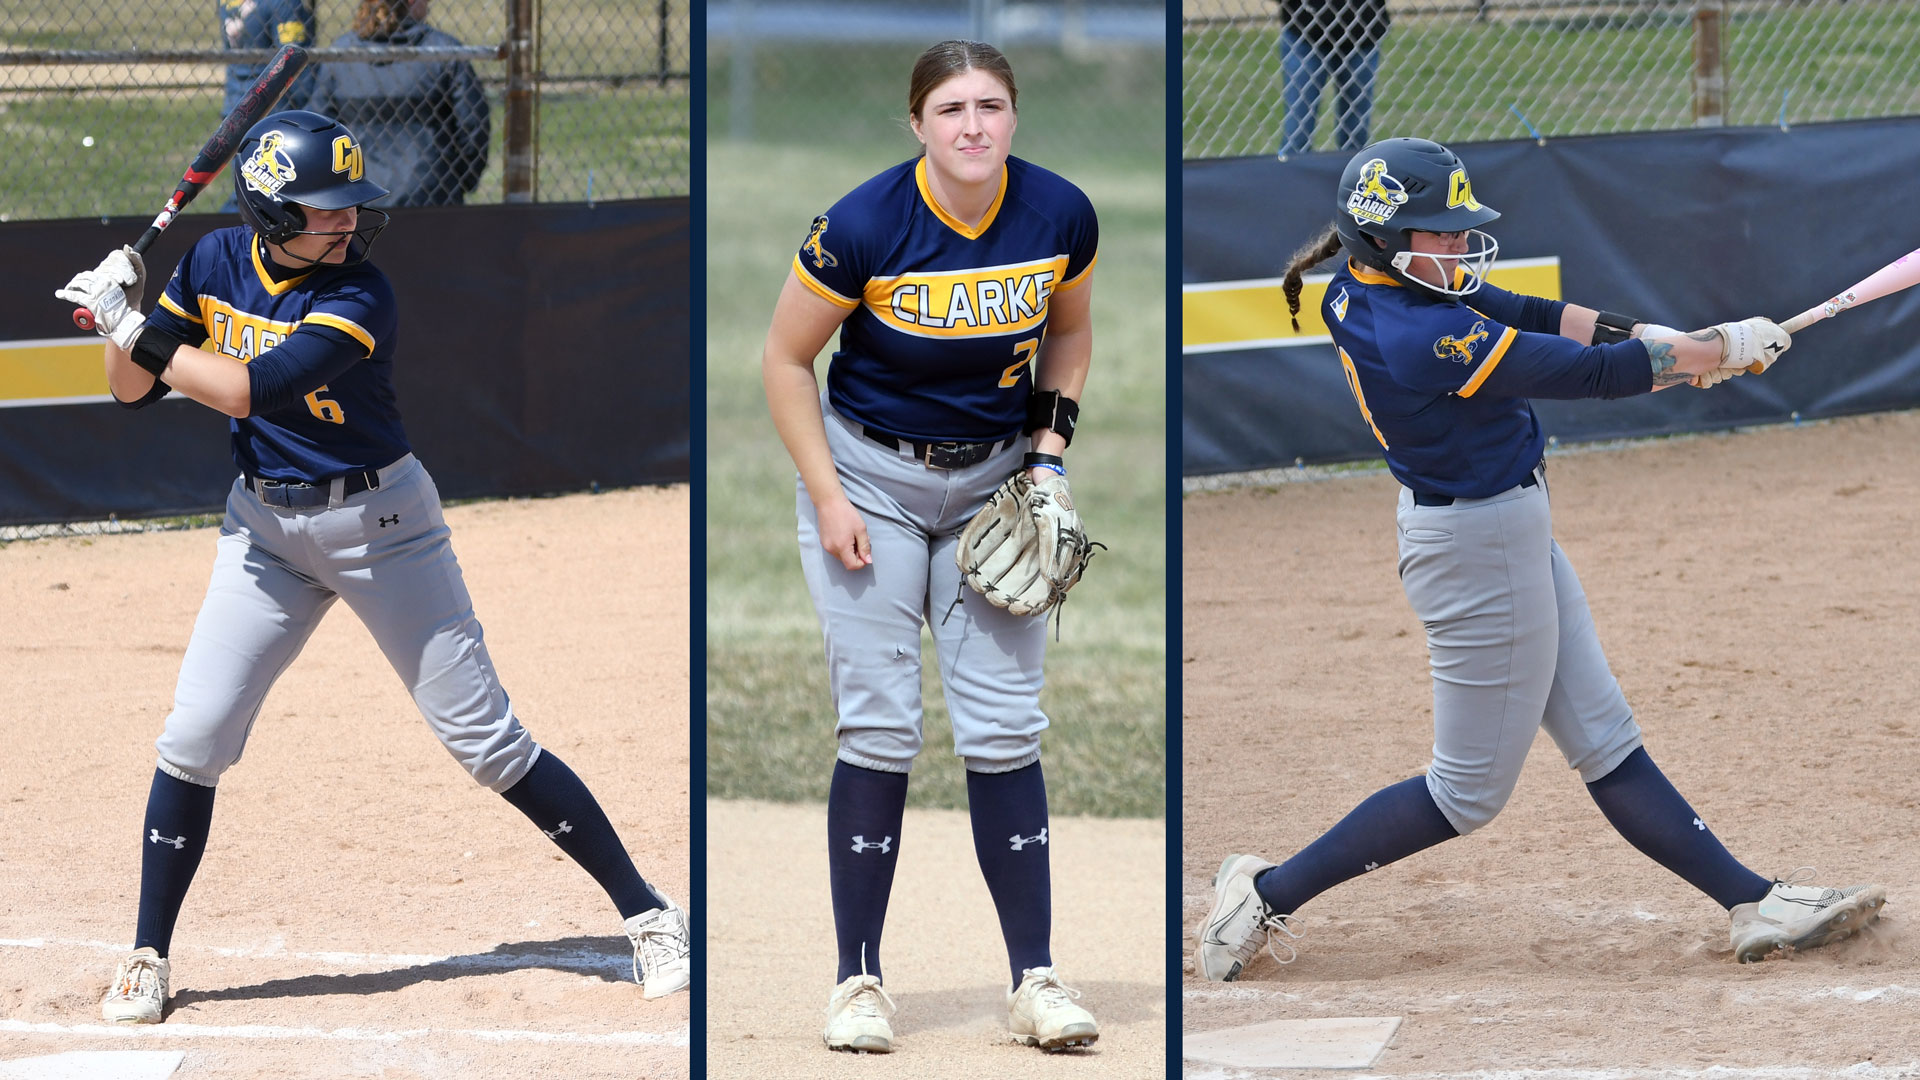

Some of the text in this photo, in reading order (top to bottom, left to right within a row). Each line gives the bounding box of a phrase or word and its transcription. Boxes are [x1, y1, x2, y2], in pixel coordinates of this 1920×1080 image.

[243, 161, 282, 191] CLARKE
[332, 135, 364, 182] CU
[1350, 193, 1395, 218] CLARKE
[891, 270, 1055, 328] CLARKE
[213, 311, 288, 360] CLAR
[998, 325, 1047, 388] 2
[304, 385, 345, 425] 6
